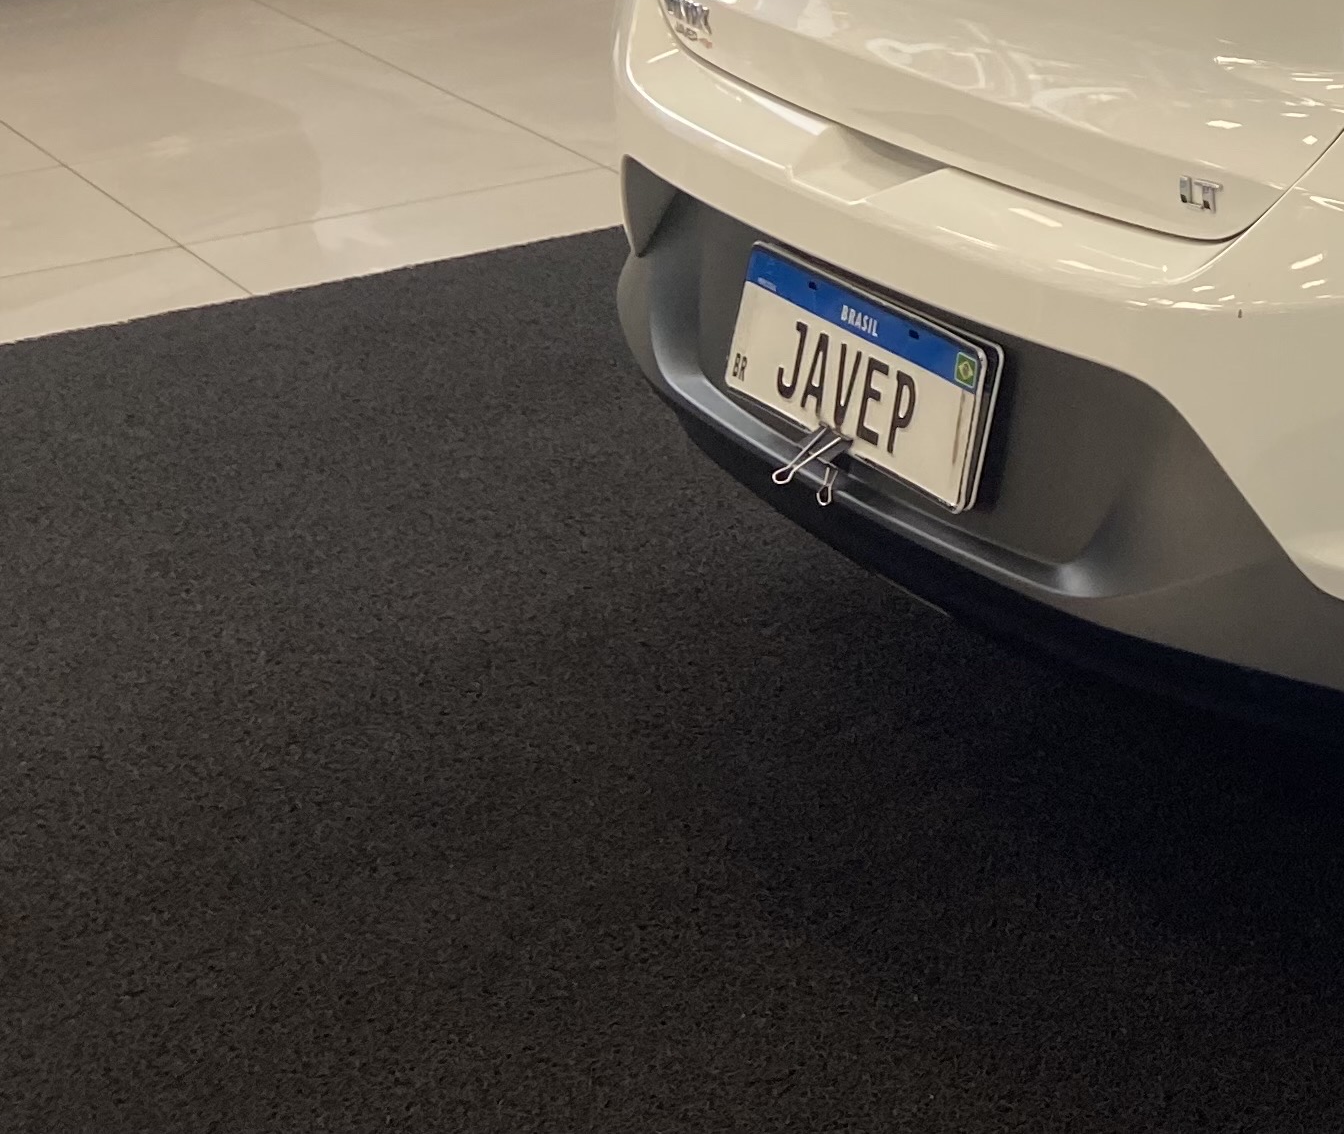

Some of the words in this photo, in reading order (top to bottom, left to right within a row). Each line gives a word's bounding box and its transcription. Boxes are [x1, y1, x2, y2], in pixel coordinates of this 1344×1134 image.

[1179, 175, 1223, 214] LT
[840, 304, 879, 338] BRASIL
[732, 353, 748, 382] BR
[776, 320, 916, 455] JAVEP
